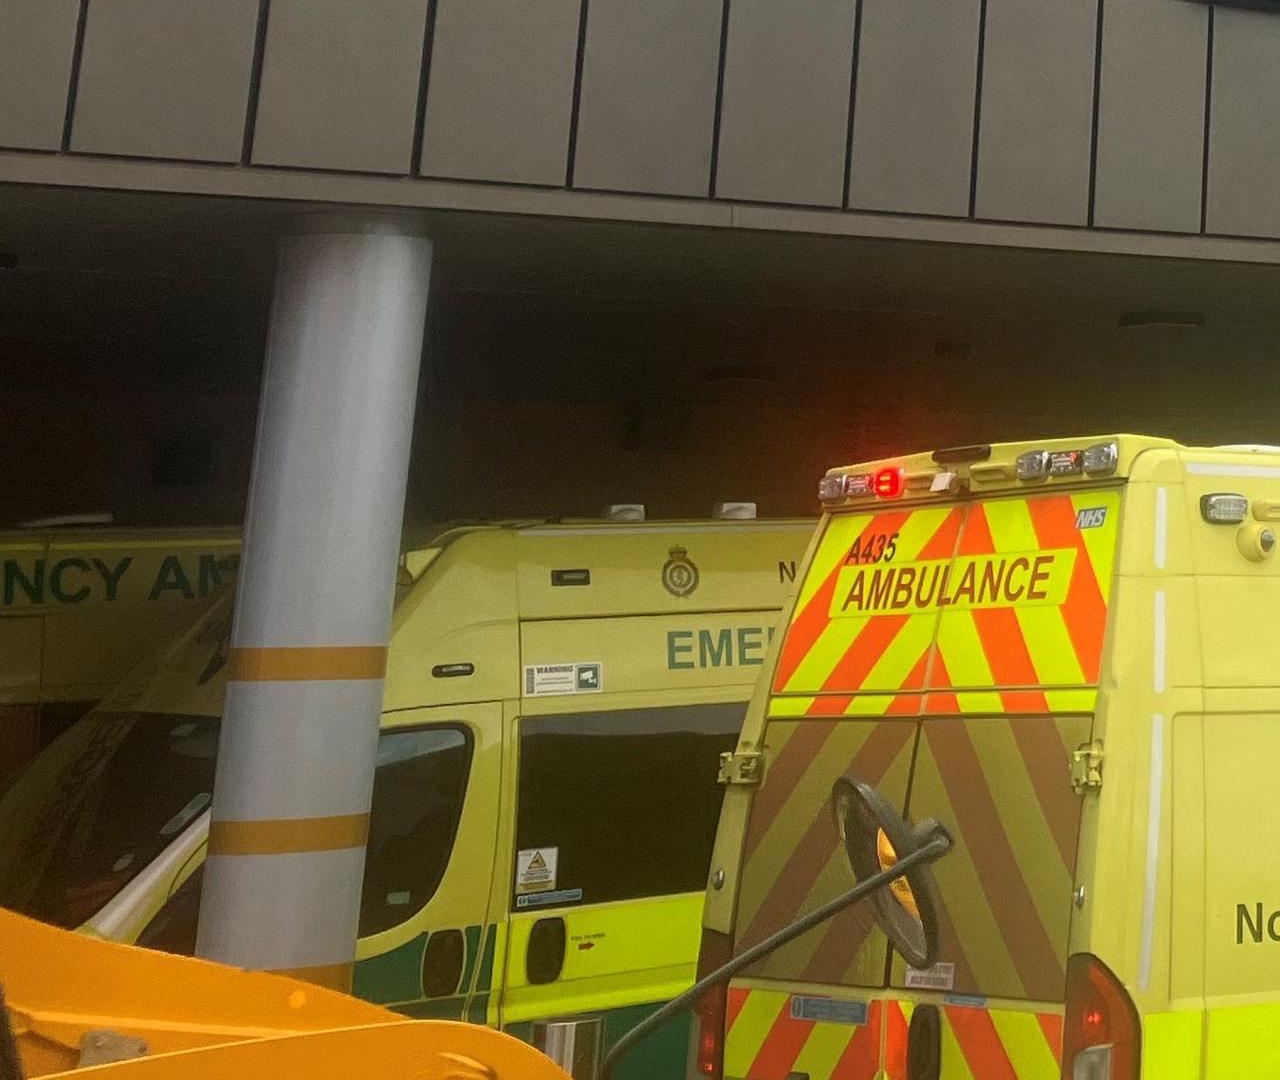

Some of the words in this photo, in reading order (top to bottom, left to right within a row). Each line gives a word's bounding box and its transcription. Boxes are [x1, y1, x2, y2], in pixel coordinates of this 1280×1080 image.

[1075, 506, 1106, 529] NHS
[845, 532, 899, 565] A435
[841, 556, 1054, 612] AMBULANCE
